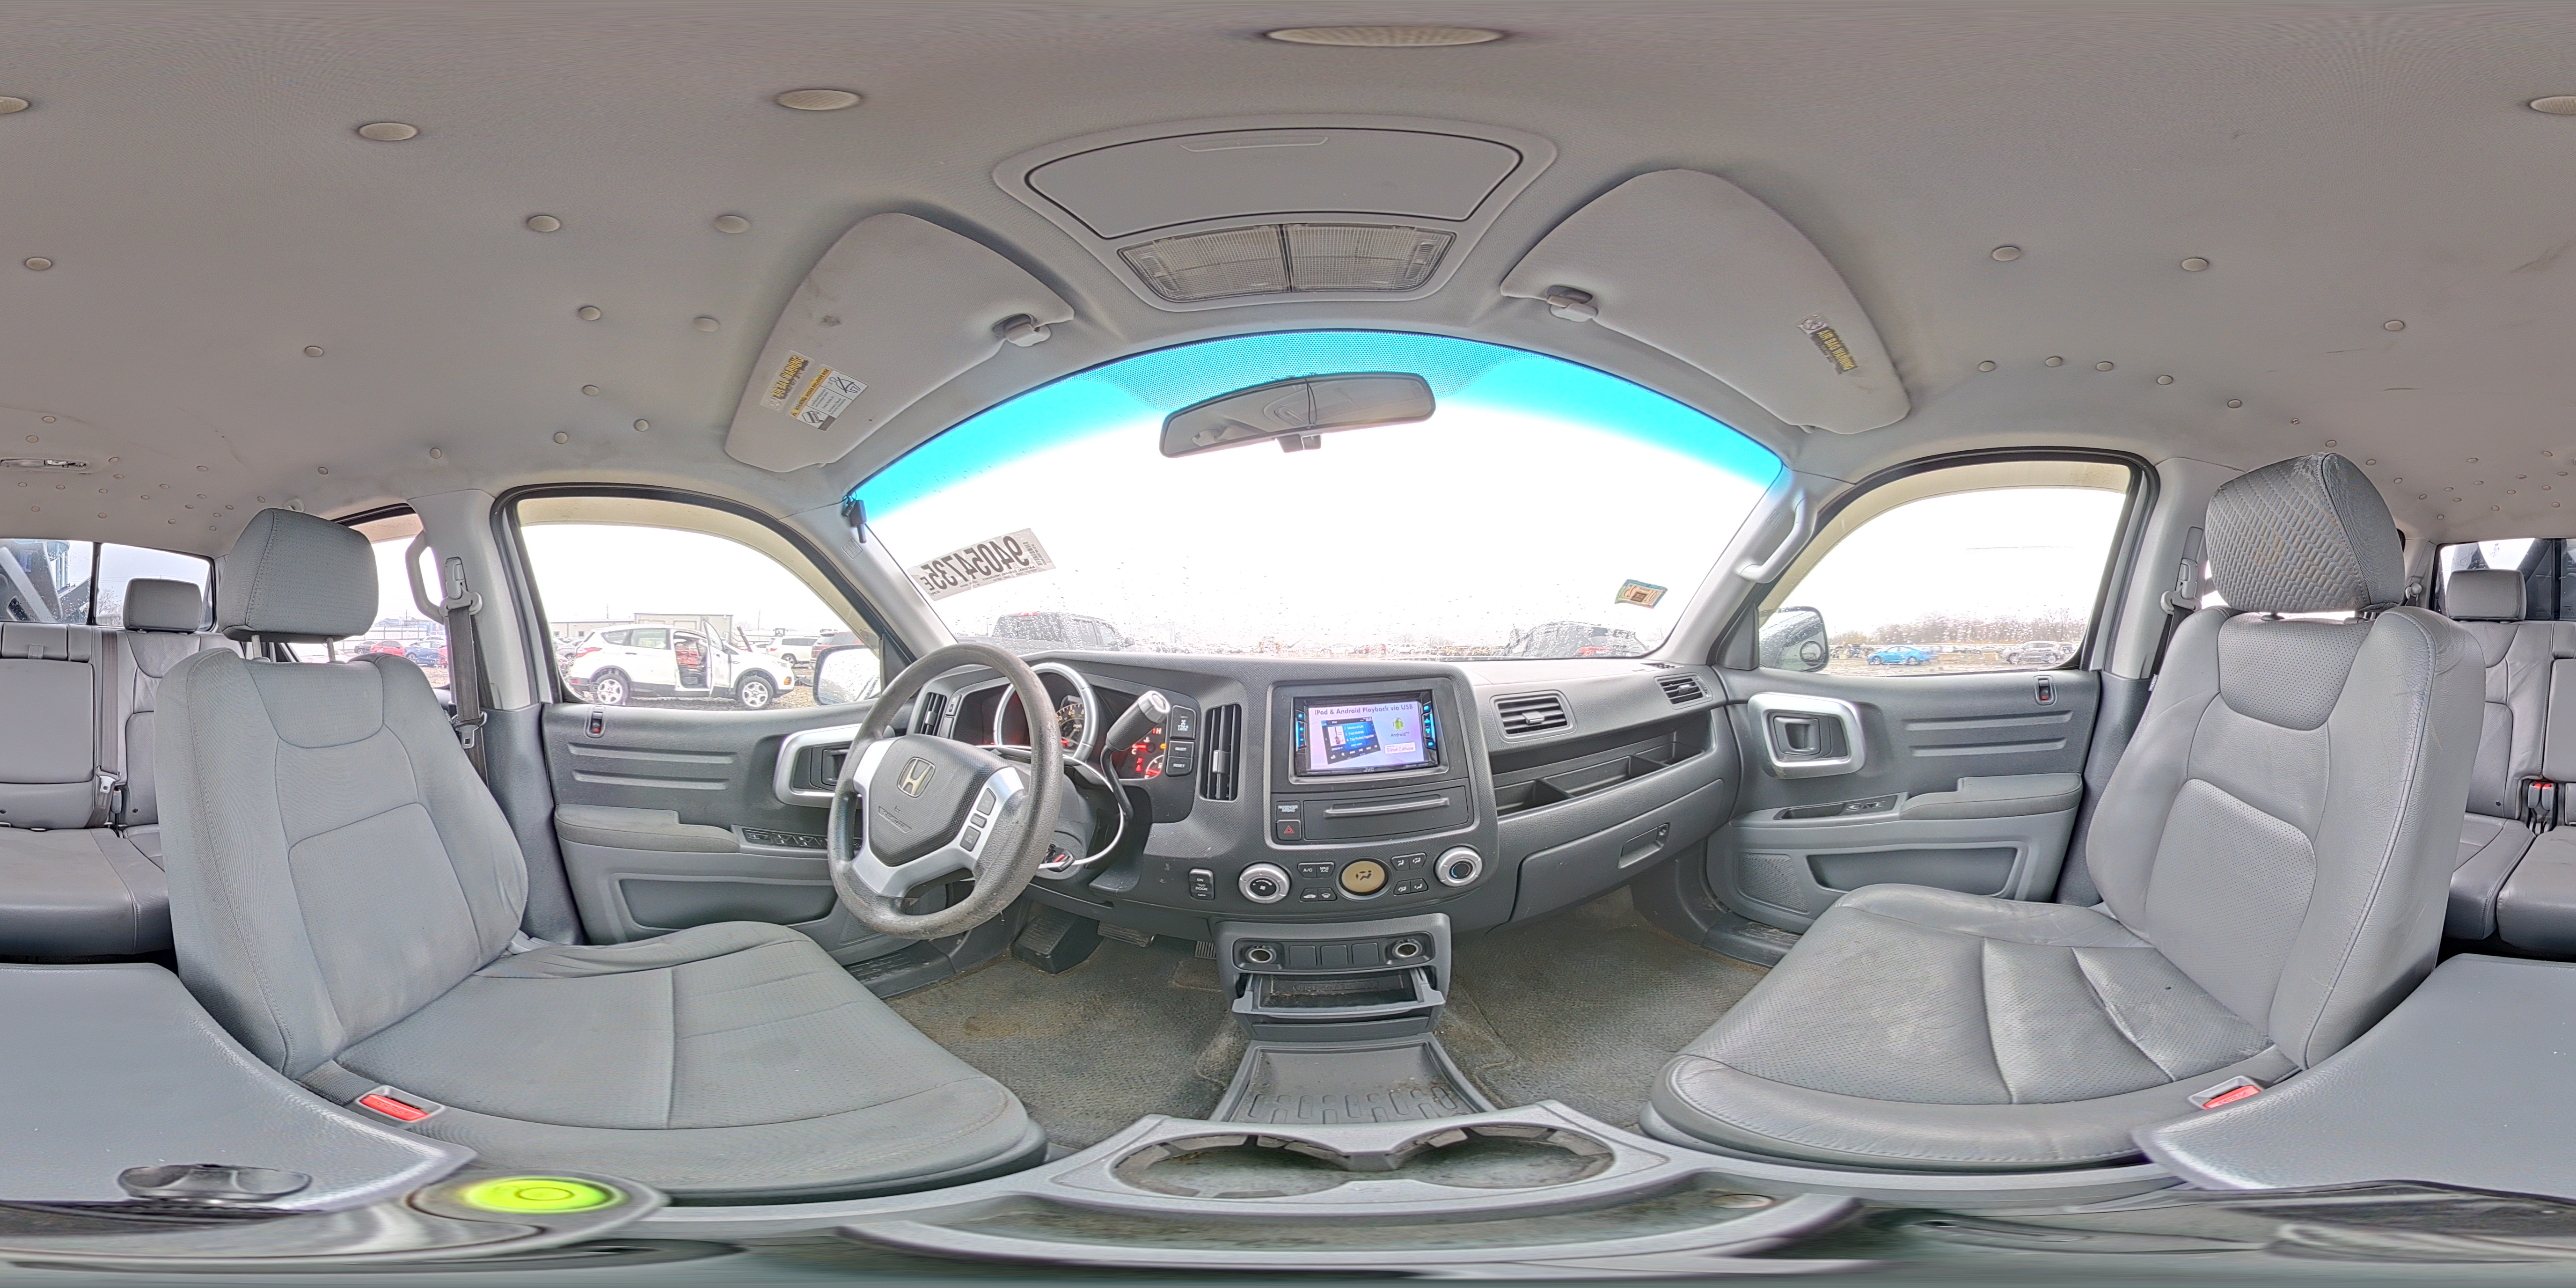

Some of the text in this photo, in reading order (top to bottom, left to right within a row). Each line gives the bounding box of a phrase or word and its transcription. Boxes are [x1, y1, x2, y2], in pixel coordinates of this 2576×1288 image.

[1816, 329, 1855, 371] AIR BAG WARNING
[780, 355, 804, 380] WARNING
[1362, 705, 1389, 713] Playback
